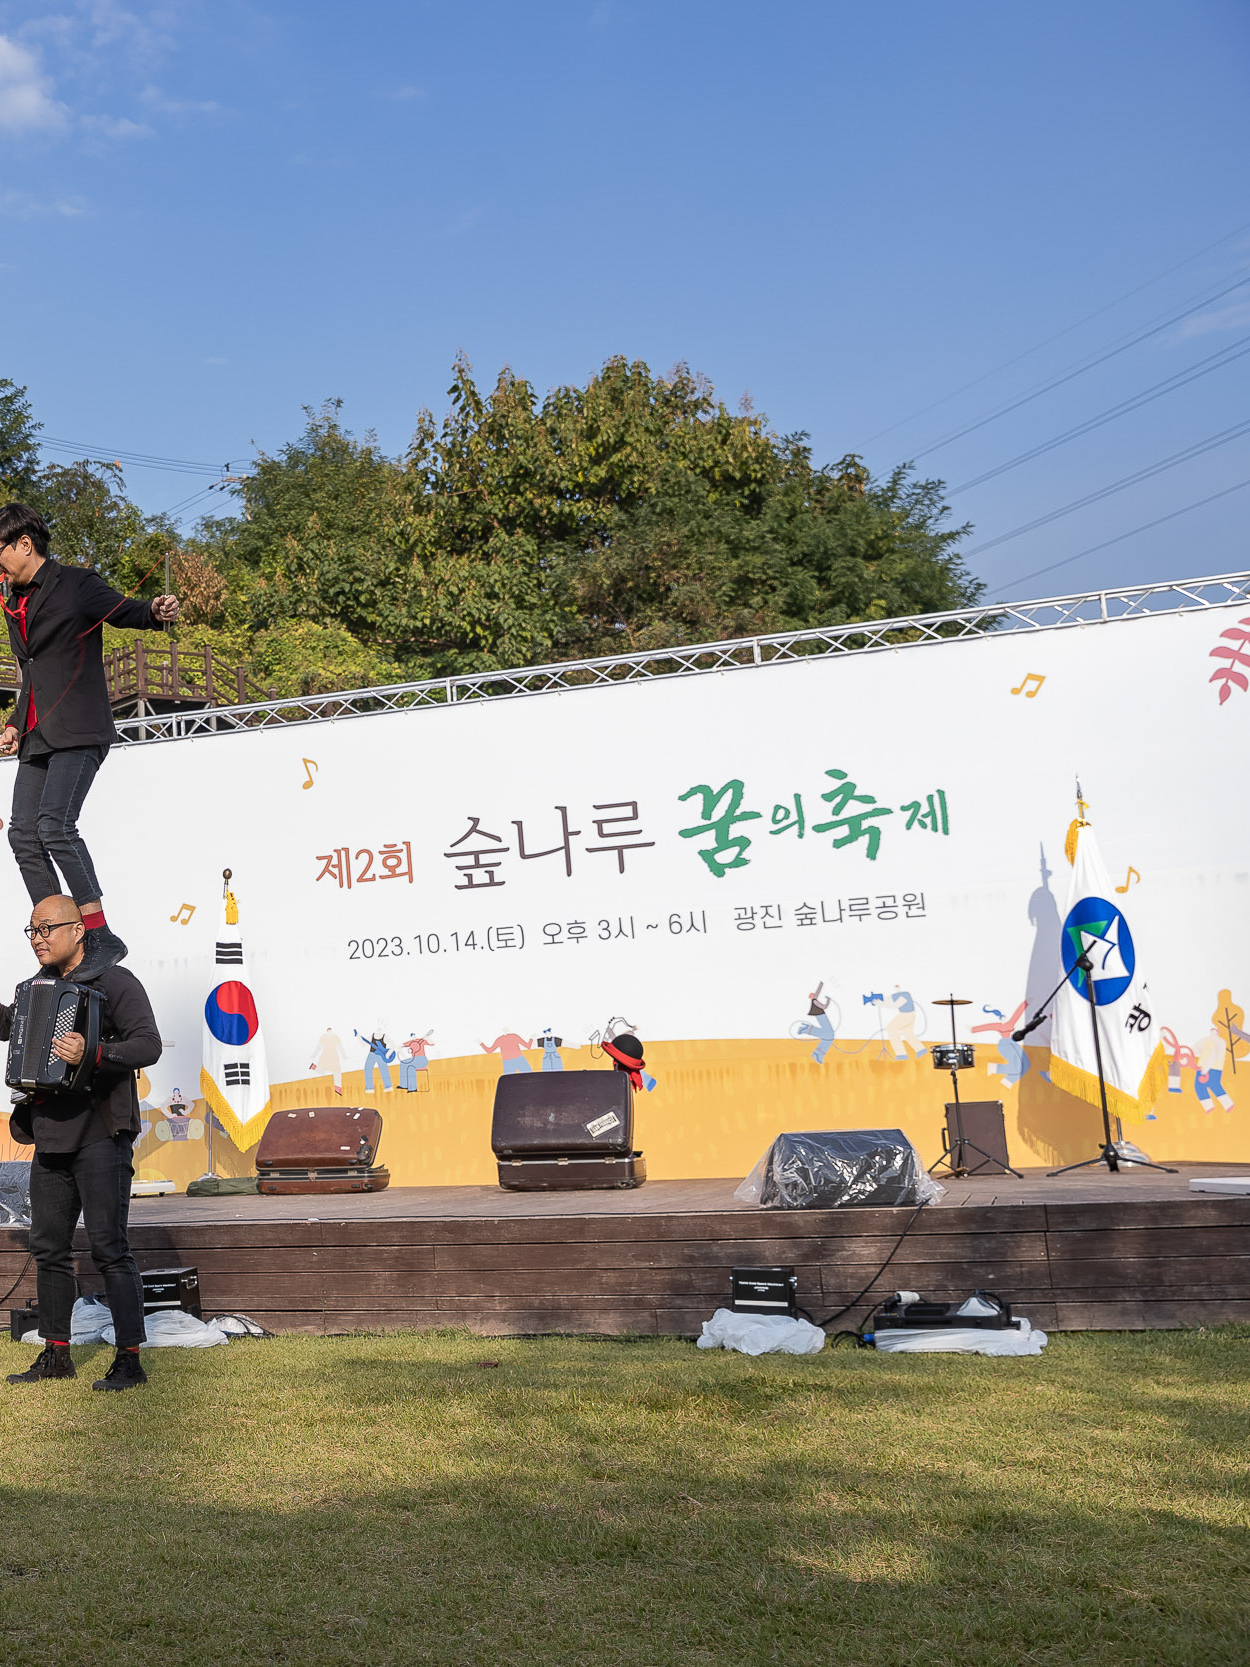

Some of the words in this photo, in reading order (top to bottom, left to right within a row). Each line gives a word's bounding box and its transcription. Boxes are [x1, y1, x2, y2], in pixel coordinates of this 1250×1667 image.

[316, 840, 414, 890] 제2회
[443, 800, 656, 891] 숲나루
[347, 924, 525, 960] 2023.10.14.(토)
[542, 919, 588, 946] 오후
[597, 915, 635, 941] 3시
[668, 909, 707, 935] 6시
[733, 903, 783, 932] 광진
[794, 892, 927, 927] 숲나루공원
